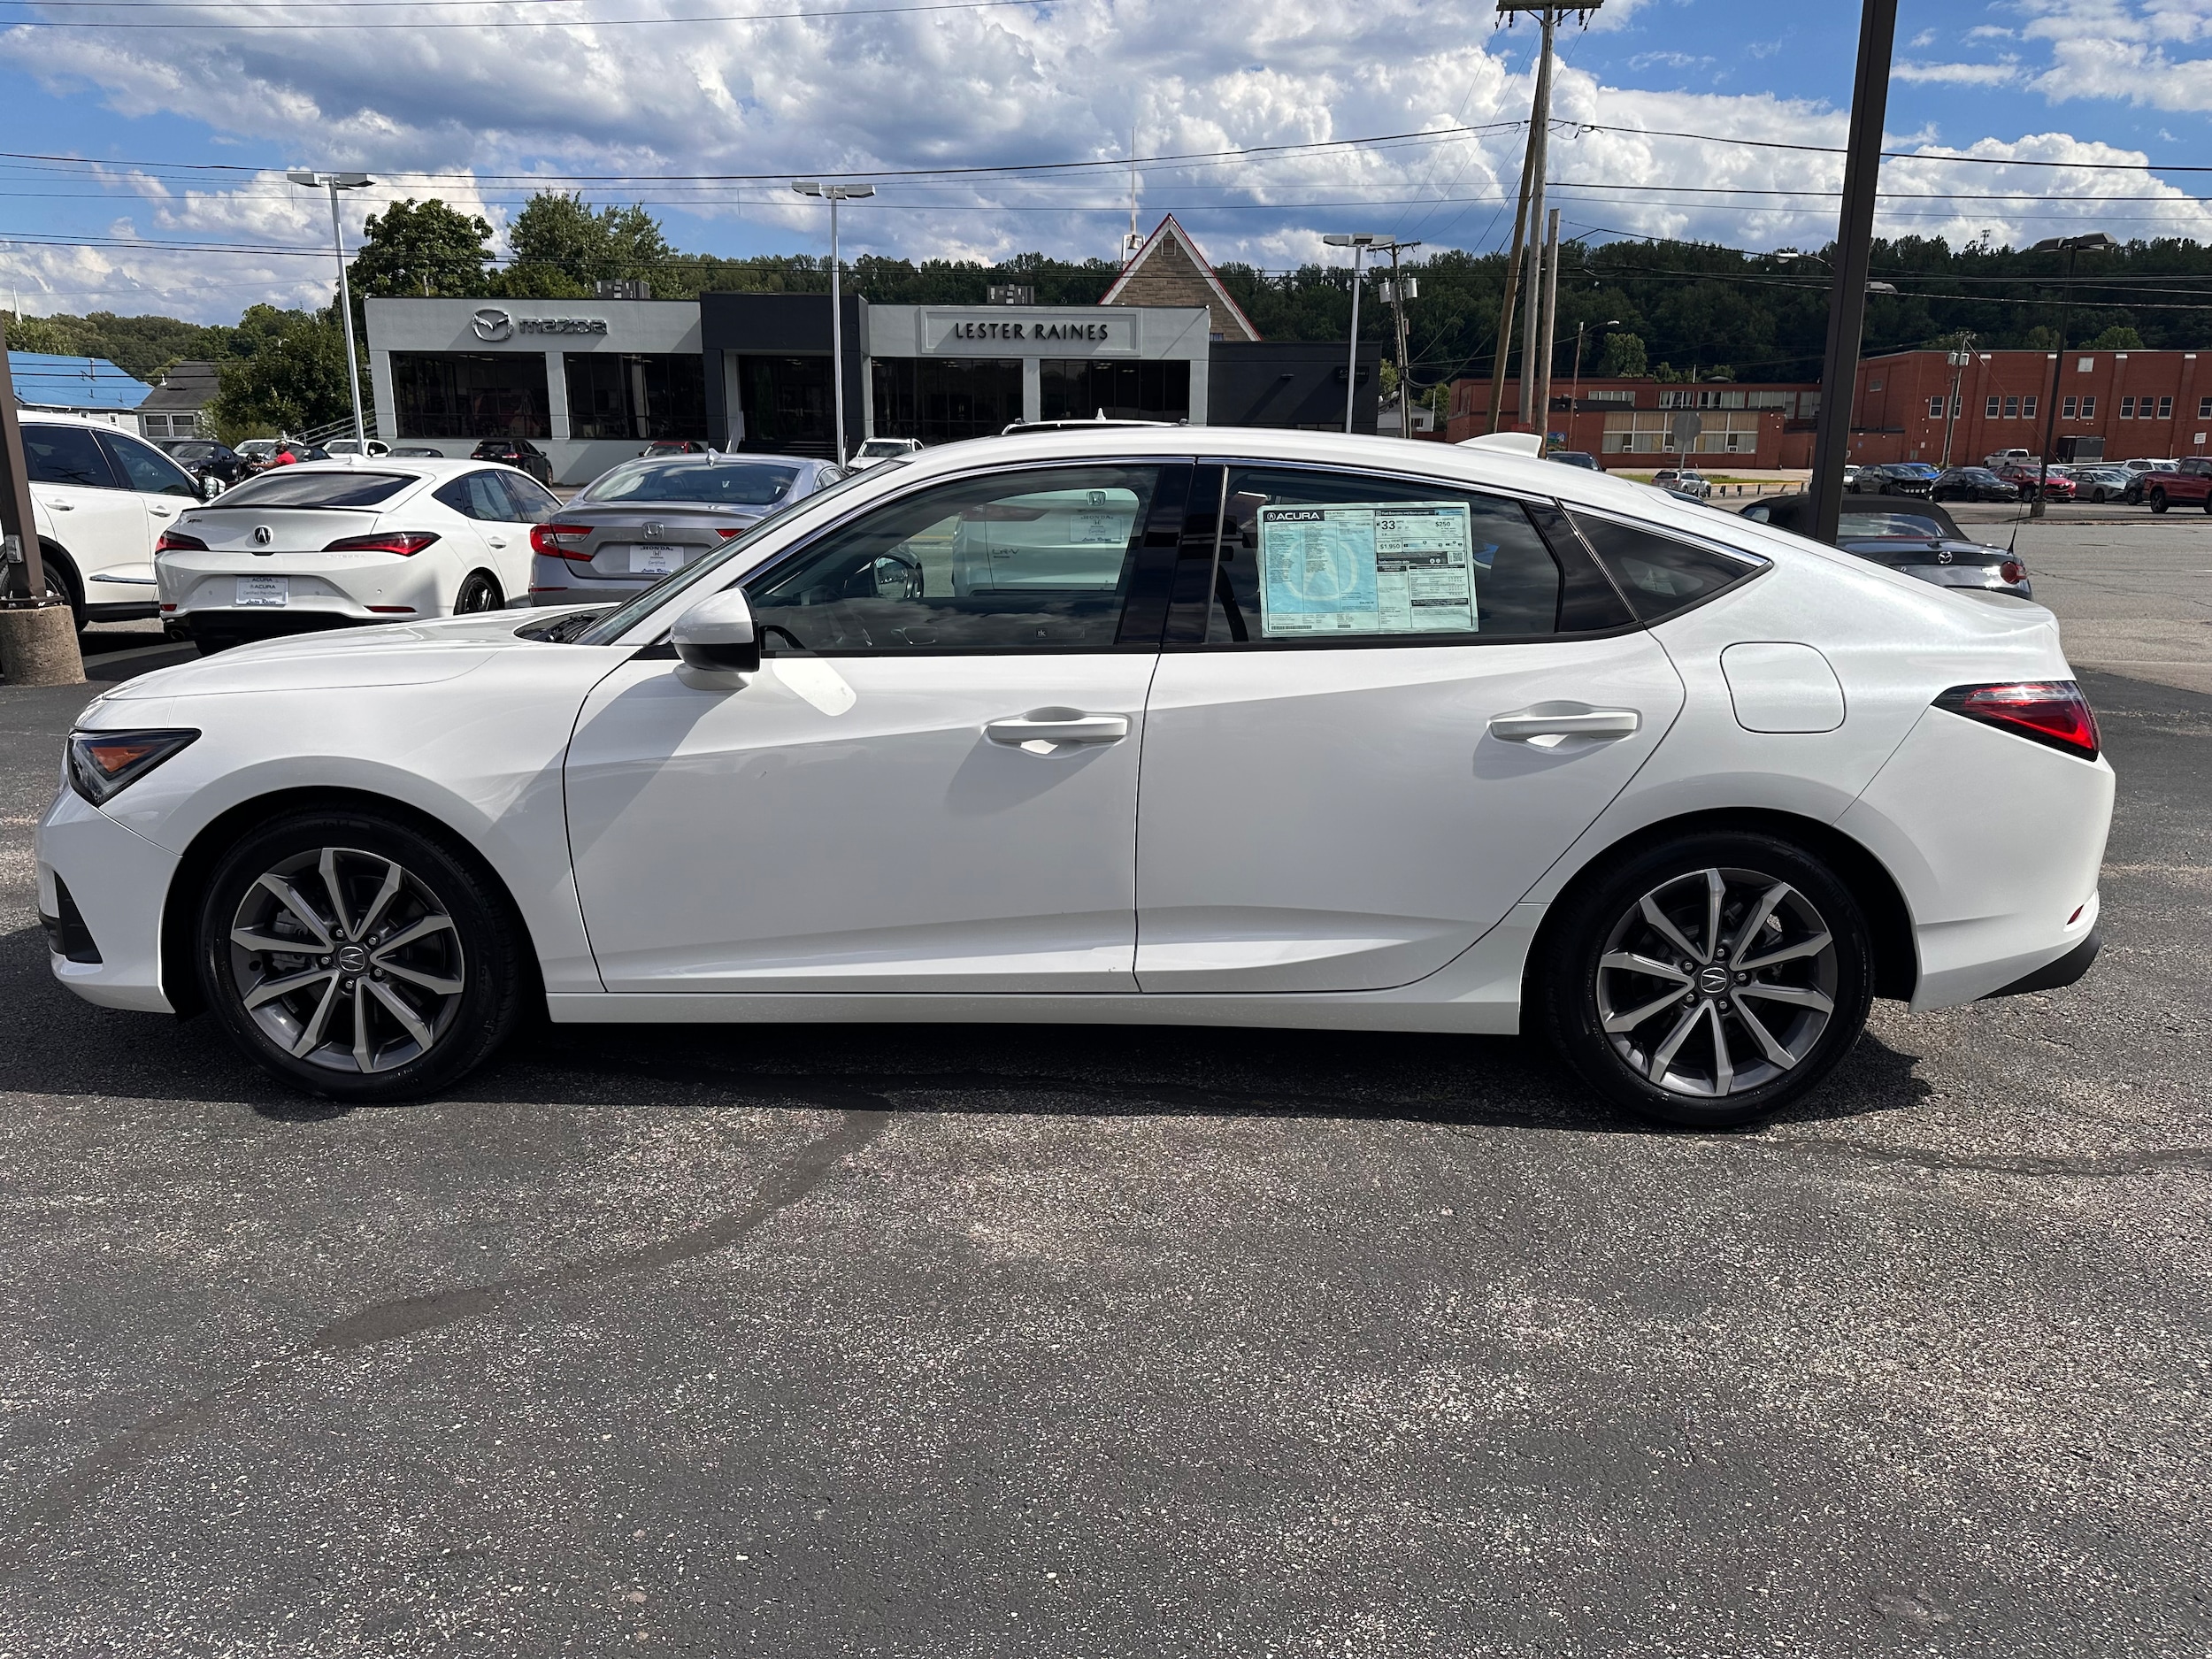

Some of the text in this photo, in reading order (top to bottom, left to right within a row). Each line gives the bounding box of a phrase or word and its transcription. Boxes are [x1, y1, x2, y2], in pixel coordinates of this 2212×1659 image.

[518, 318, 608, 334] mazda
[956, 322, 1109, 341] LESTER RAINES
[1276, 512, 1320, 520] ACURA
[1381, 520, 1395, 530] 33
